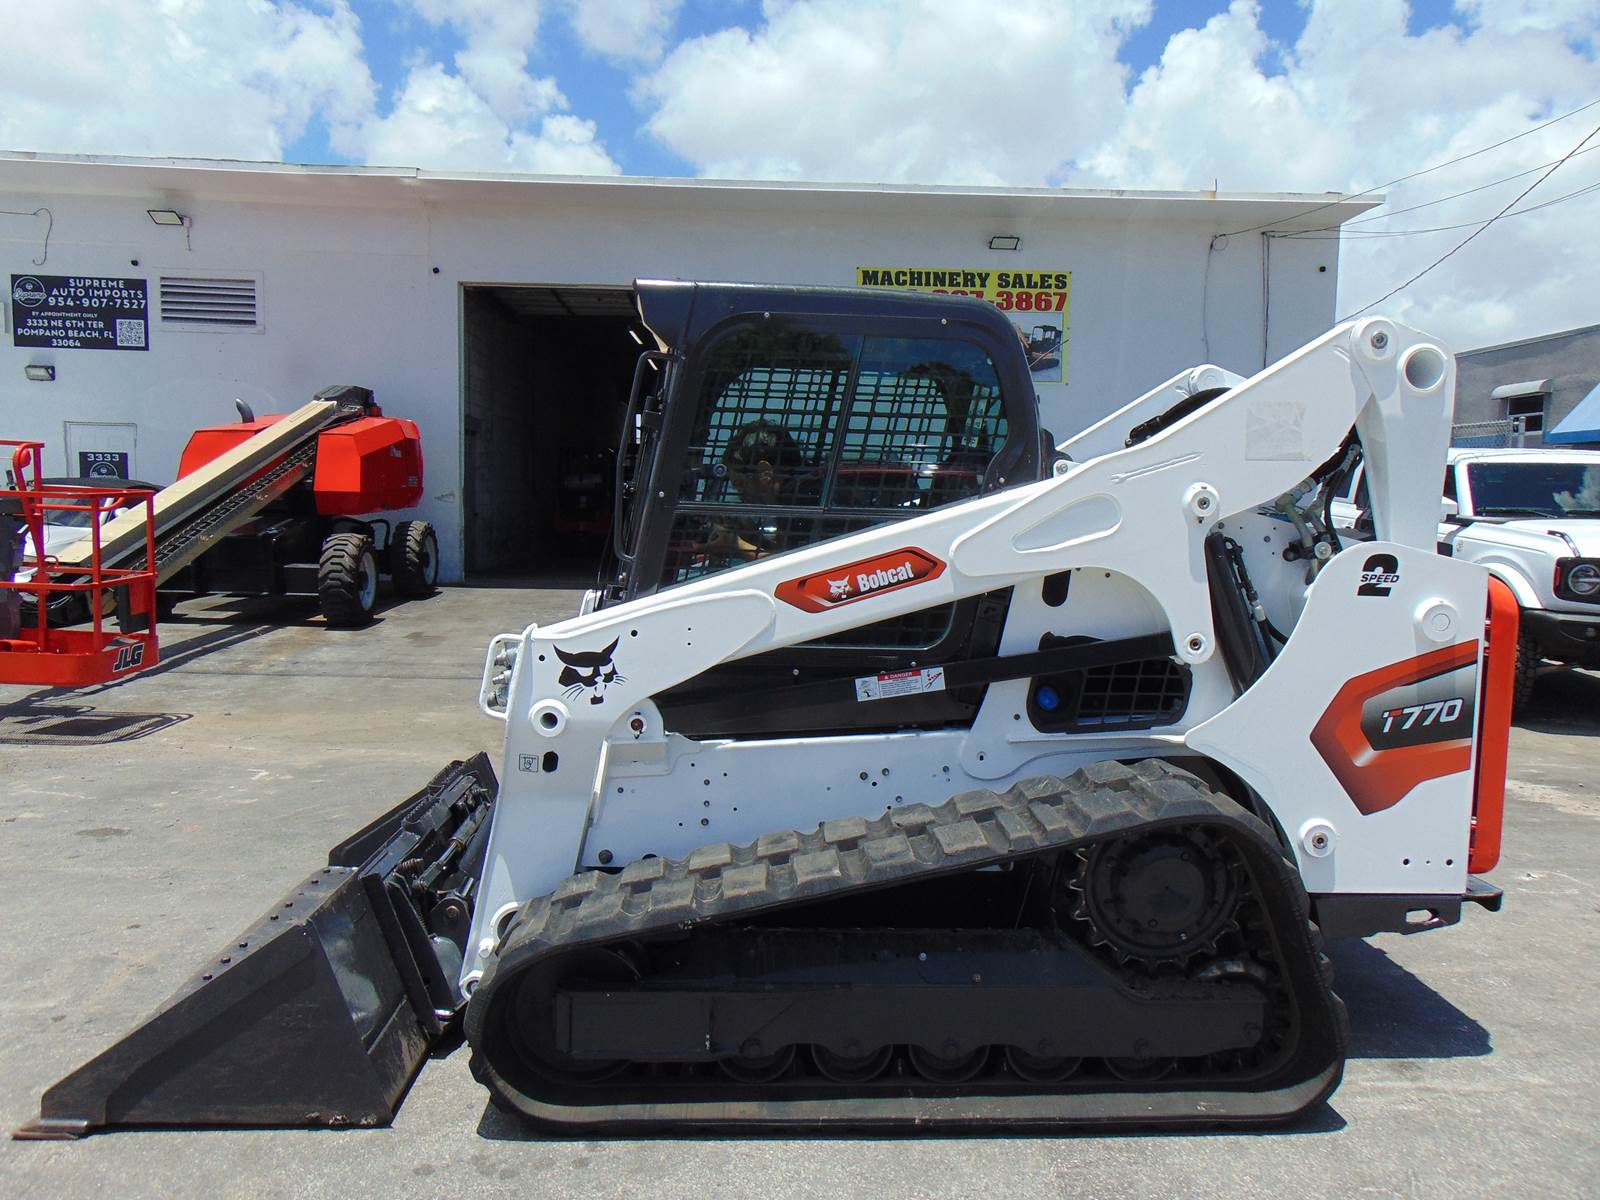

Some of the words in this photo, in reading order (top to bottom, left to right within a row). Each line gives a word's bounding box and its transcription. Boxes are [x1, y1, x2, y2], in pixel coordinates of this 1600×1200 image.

[69, 279, 125, 288] SUPREME
[862, 270, 990, 288] MACHINERY
[997, 272, 1067, 289] SALES
[52, 288, 85, 297] AUTO
[89, 289, 143, 298] IMPORTS
[48, 297, 146, 309] 954-907-7527
[26, 319, 48, 327] 3333
[50, 320, 63, 328] NE
[65, 320, 85, 328] 6TH
[87, 321, 105, 329] TER
[17, 328, 65, 337] POMPANO
[68, 329, 102, 339] BEACH,
[104, 331, 115, 339] FL
[51, 338, 81, 347] 33064
[87, 453, 119, 461] 3333
[857, 561, 915, 593] Bobcat
[1360, 573, 1400, 583] SPEED
[113, 642, 144, 672] JLG
[889, 671, 913, 679] DANGER
[1382, 697, 1464, 733] T770
